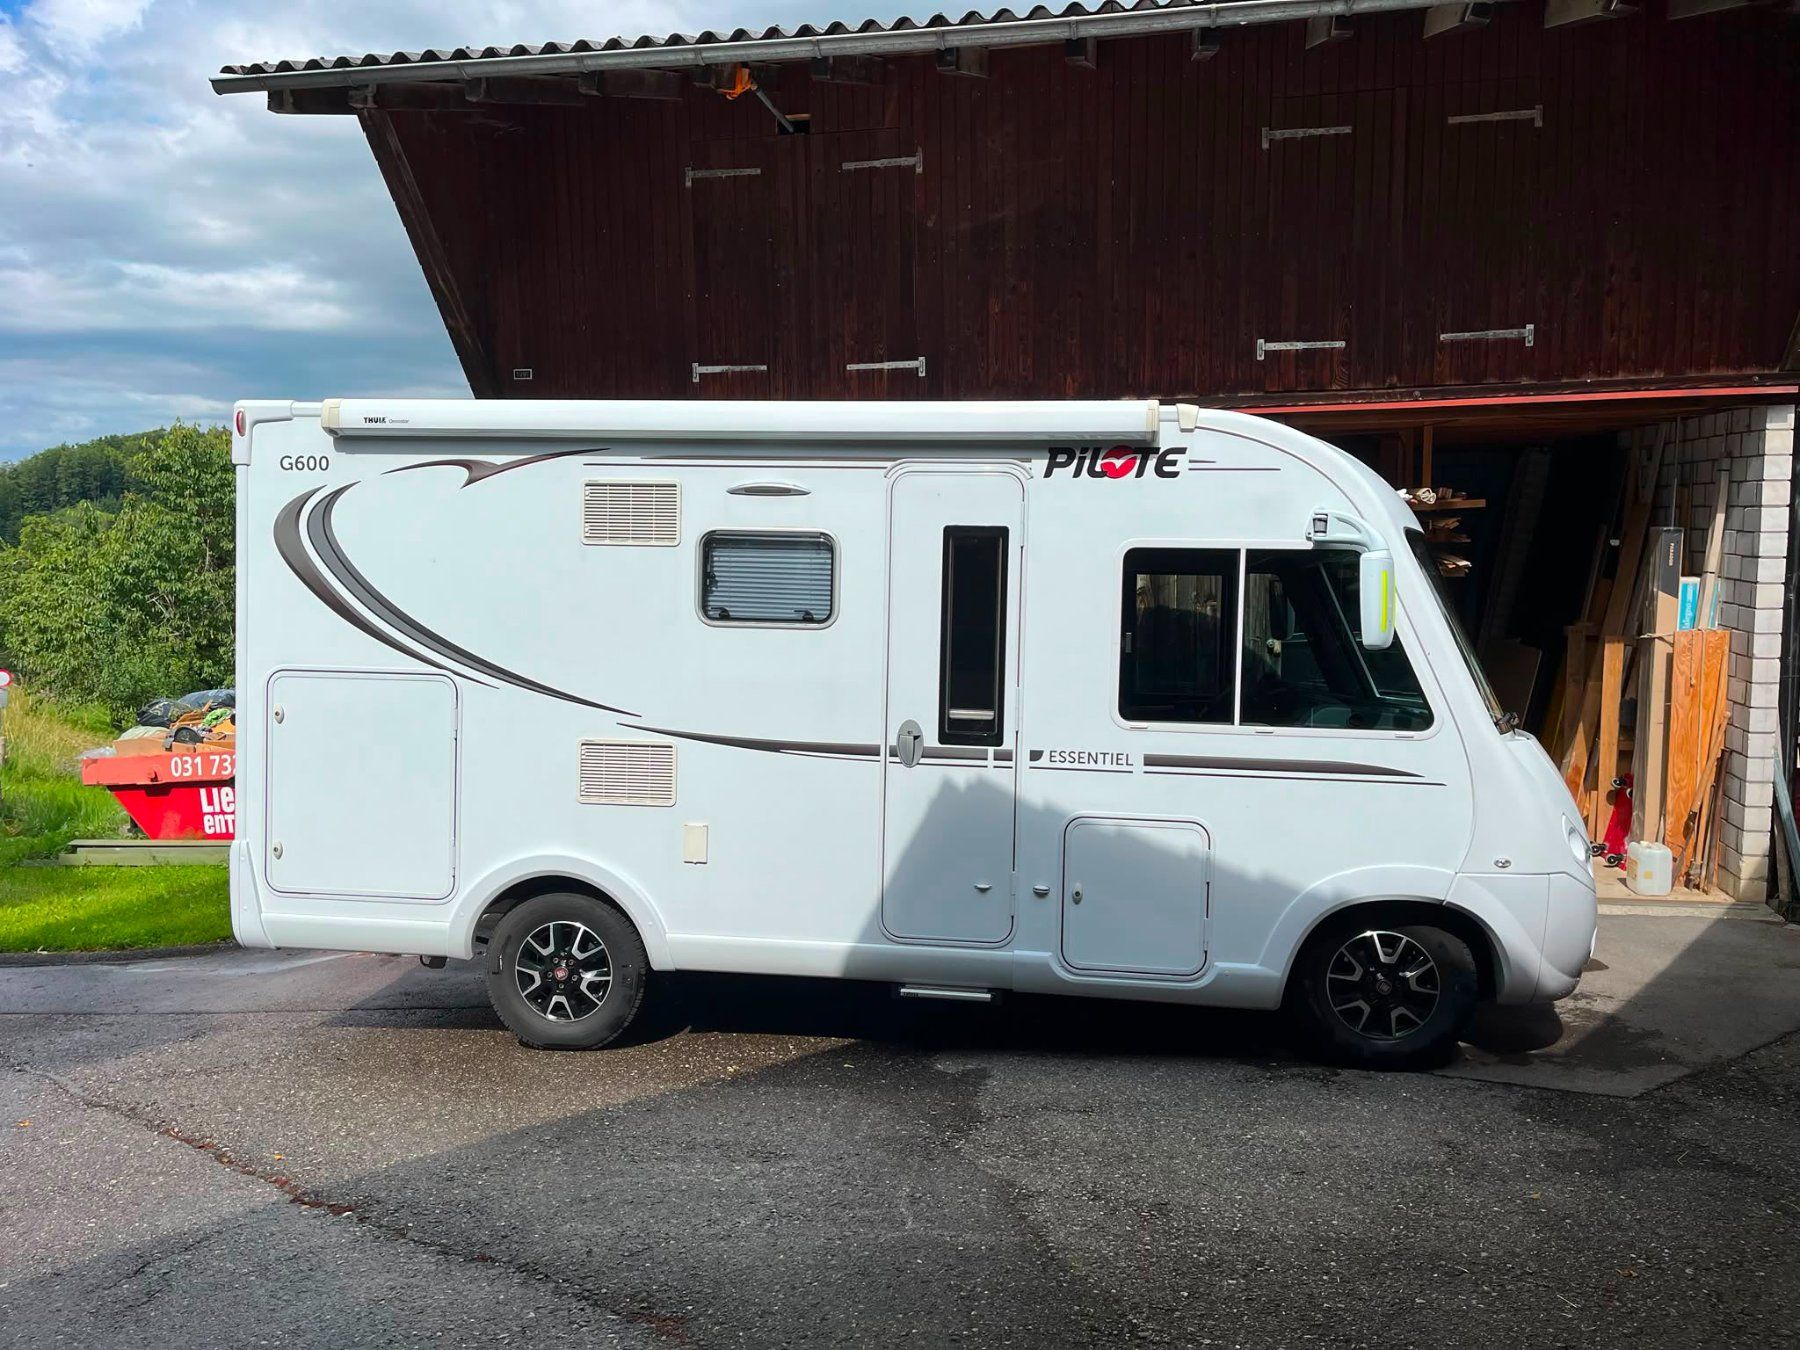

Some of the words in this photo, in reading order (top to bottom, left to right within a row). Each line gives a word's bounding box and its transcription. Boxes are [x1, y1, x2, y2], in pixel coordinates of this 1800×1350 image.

[363, 416, 387, 424] THULE
[279, 455, 330, 472] G600
[170, 756, 202, 777] 031
[1049, 750, 1134, 767] ESSENTIEL
